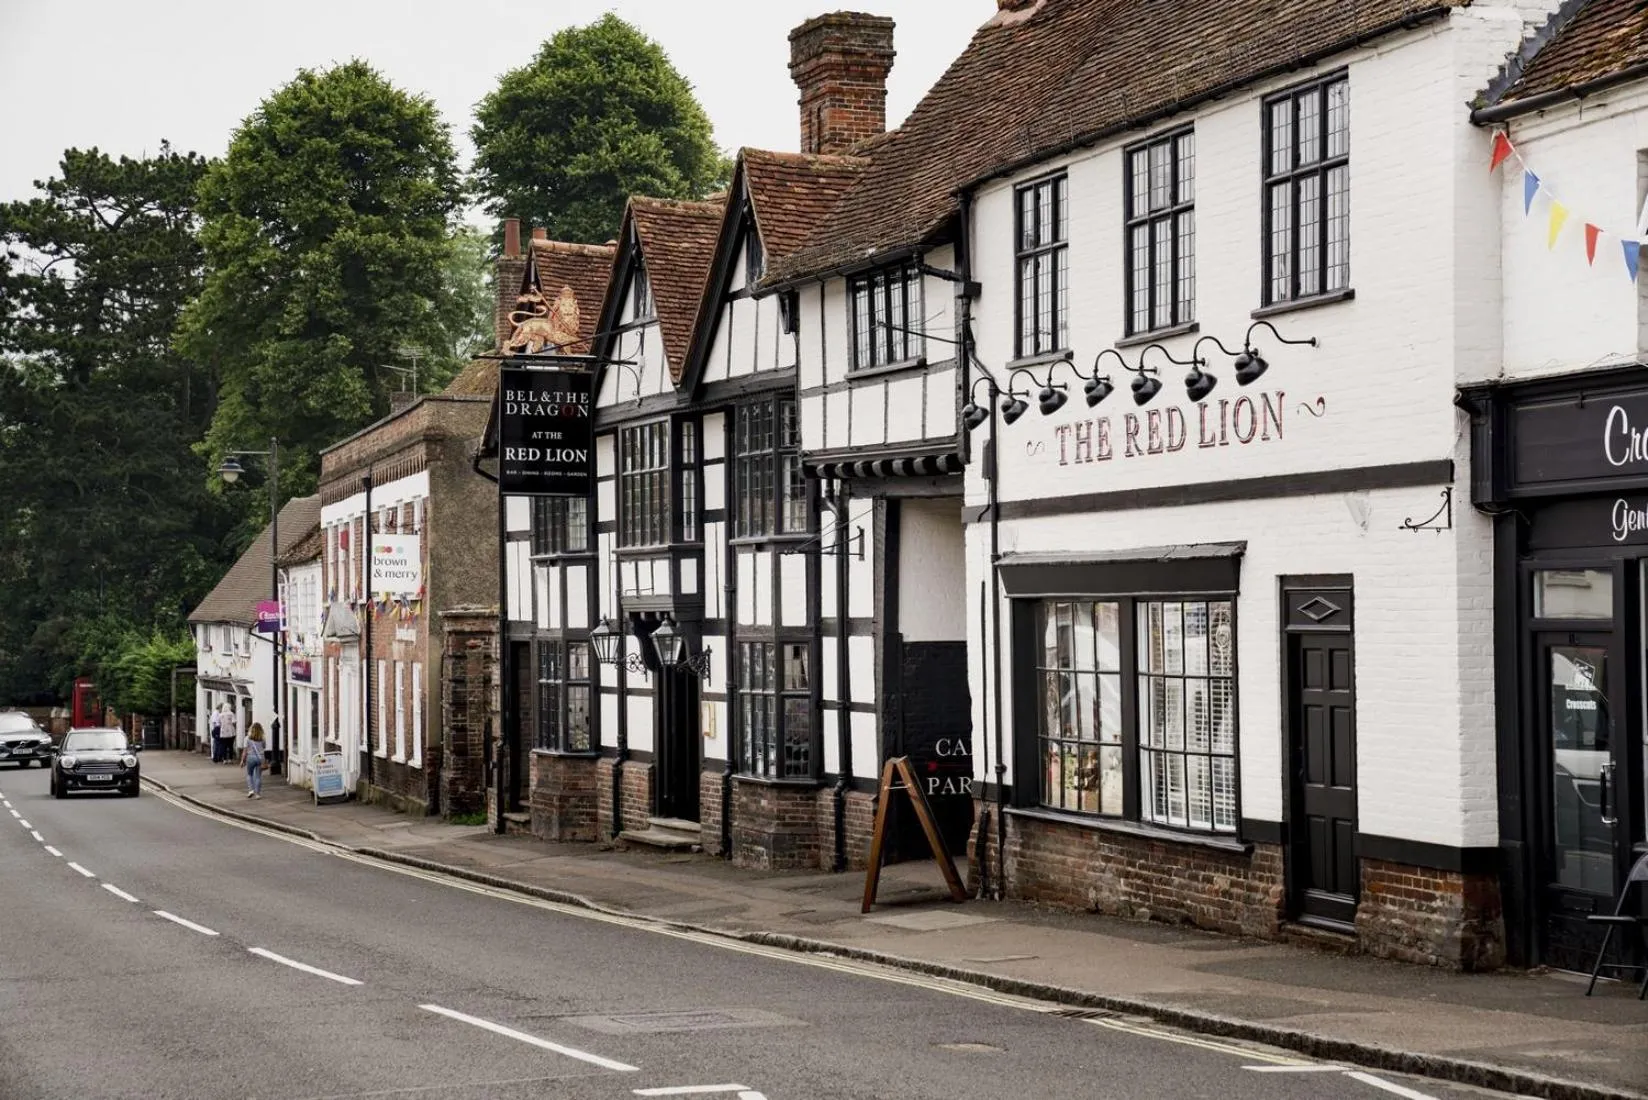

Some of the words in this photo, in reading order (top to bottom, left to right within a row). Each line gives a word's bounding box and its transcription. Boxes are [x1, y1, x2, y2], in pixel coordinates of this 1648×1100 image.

[505, 402, 589, 417] DRAGON
[532, 431, 543, 440] AT
[544, 431, 563, 440] THE
[1055, 416, 1113, 466] THE
[1123, 406, 1187, 458] RED
[1197, 391, 1285, 449] LION
[505, 447, 541, 461] RED
[545, 448, 587, 463] LION
[373, 556, 407, 566] brown
[373, 569, 382, 578] &
[384, 570, 418, 581] merry
[935, 738, 973, 757] CA
